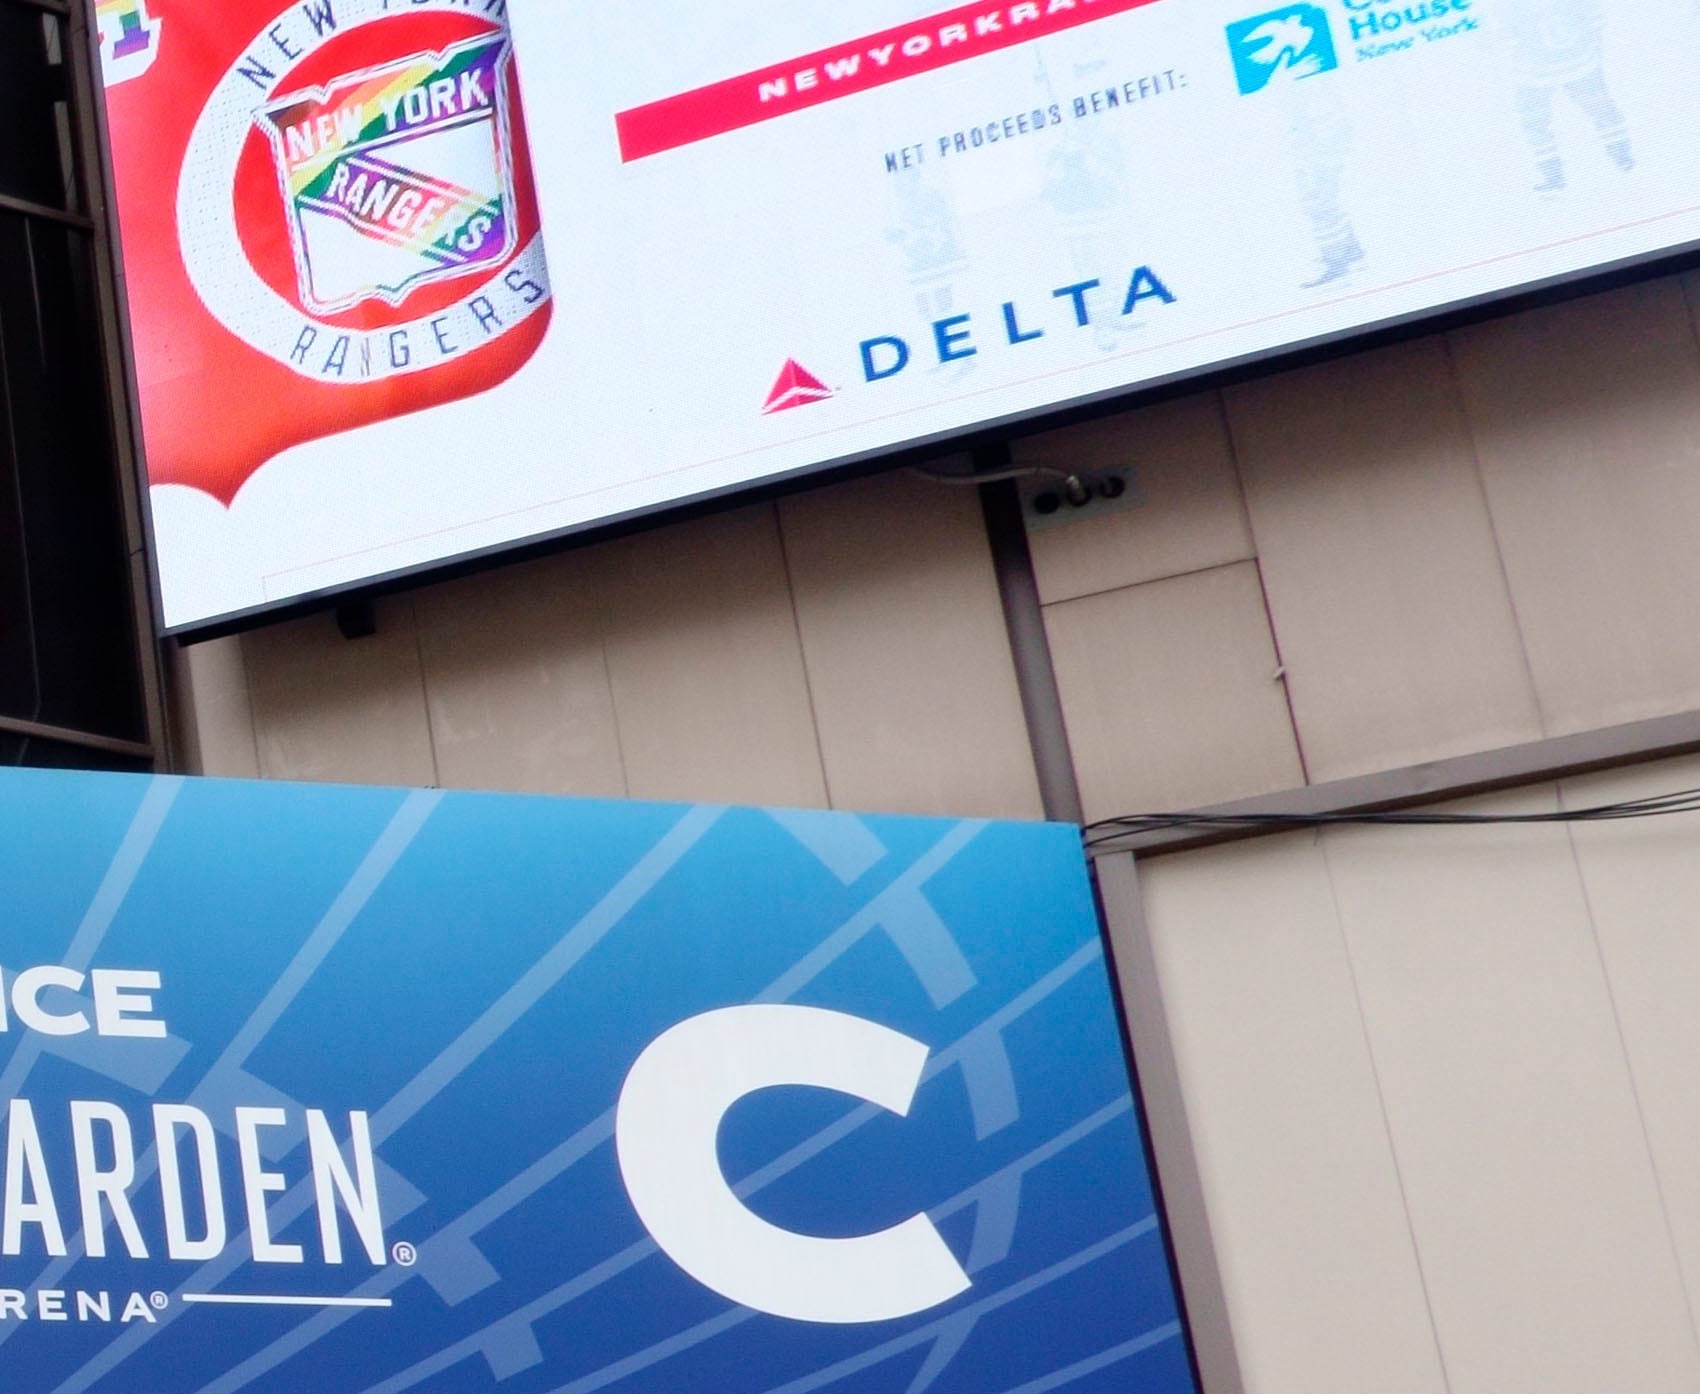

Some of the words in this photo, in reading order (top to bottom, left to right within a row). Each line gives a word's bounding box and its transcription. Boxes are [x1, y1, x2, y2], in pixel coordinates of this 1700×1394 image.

[758, 0, 1097, 102] NEWYORKRA
[1421, 16, 1479, 41] York
[285, 105, 363, 162] NEW
[381, 68, 488, 131] YORK
[885, 143, 925, 174] NET
[939, 104, 1062, 157] PROCEEDS
[1073, 69, 1188, 120] BENEFIT:
[860, 266, 1176, 383] DELTA
[616, 1004, 972, 1323] C
